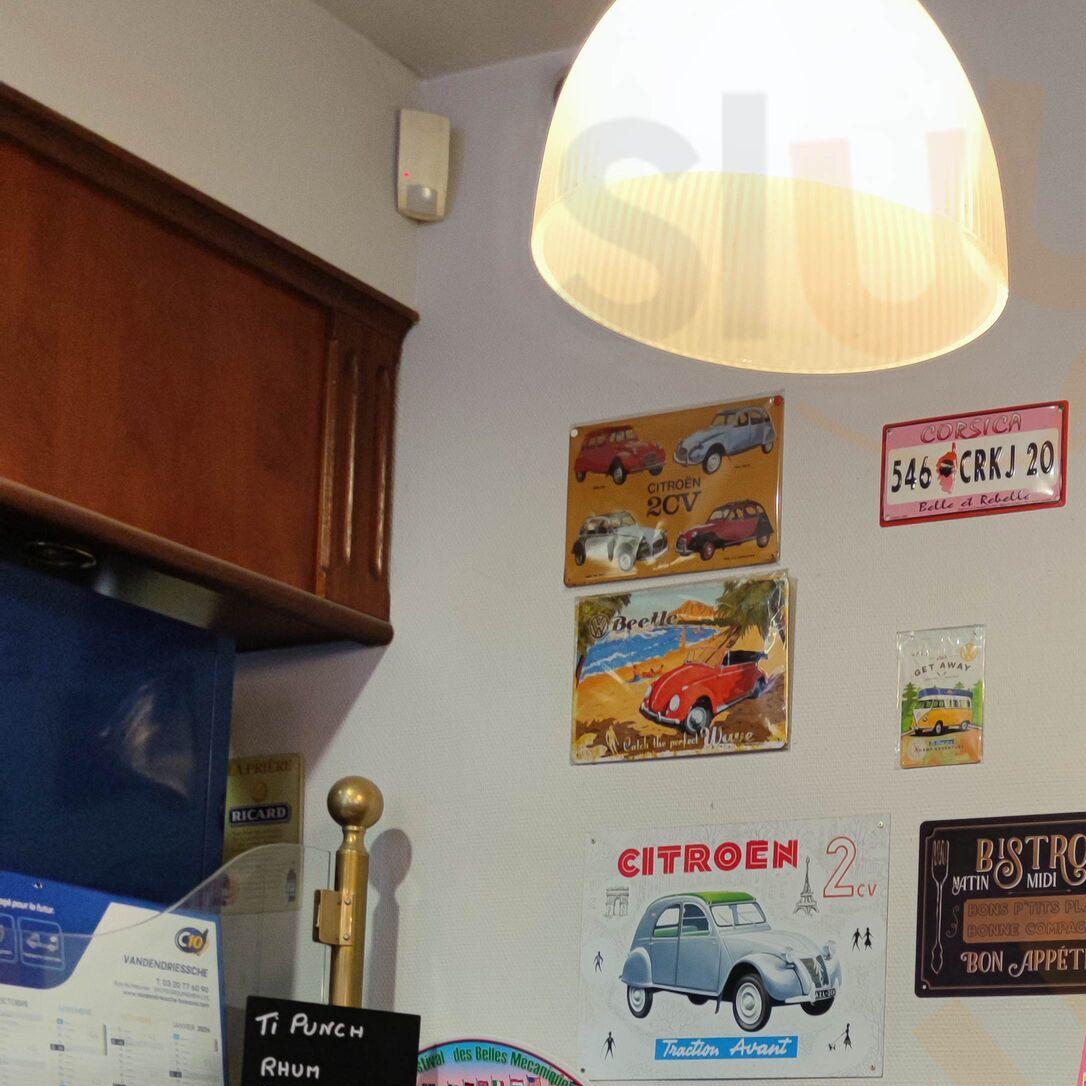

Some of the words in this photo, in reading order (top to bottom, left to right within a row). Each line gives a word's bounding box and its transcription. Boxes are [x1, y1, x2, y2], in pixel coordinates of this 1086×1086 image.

[920, 411, 1022, 444] CORSICA
[891, 456, 932, 493] 546
[959, 444, 1016, 484] CRKJ
[1026, 440, 1054, 477] 20
[647, 476, 702, 494] CITROËN
[646, 490, 703, 518] 2CV
[919, 499, 953, 513] Belle
[960, 498, 974, 508] et
[980, 489, 1031, 506] Rebelle
[611, 610, 680, 632] Beetle
[914, 663, 935, 677] GET
[940, 661, 971, 672] AWAY
[623, 736, 649, 751] Catch
[653, 737, 666, 748] the
[669, 732, 699, 749] perfect
[699, 725, 754, 750] Wave
[231, 806, 287, 822] RICARD
[617, 839, 799, 879] CITROEN
[951, 874, 990, 896] MATIN
[1026, 871, 1058, 889] MIDI
[967, 901, 1009, 917] BONS
[1013, 899, 1061, 916] P'TITS
[967, 922, 1020, 938] BONNE
[959, 950, 1005, 974] BON
[290, 1012, 364, 1039] PUNCH
[453, 1047, 472, 1063] des
[475, 1045, 508, 1064] Belles
[662, 1039, 720, 1058] Traction
[729, 1037, 793, 1057] Avant
[260, 1056, 320, 1080] RHUM
